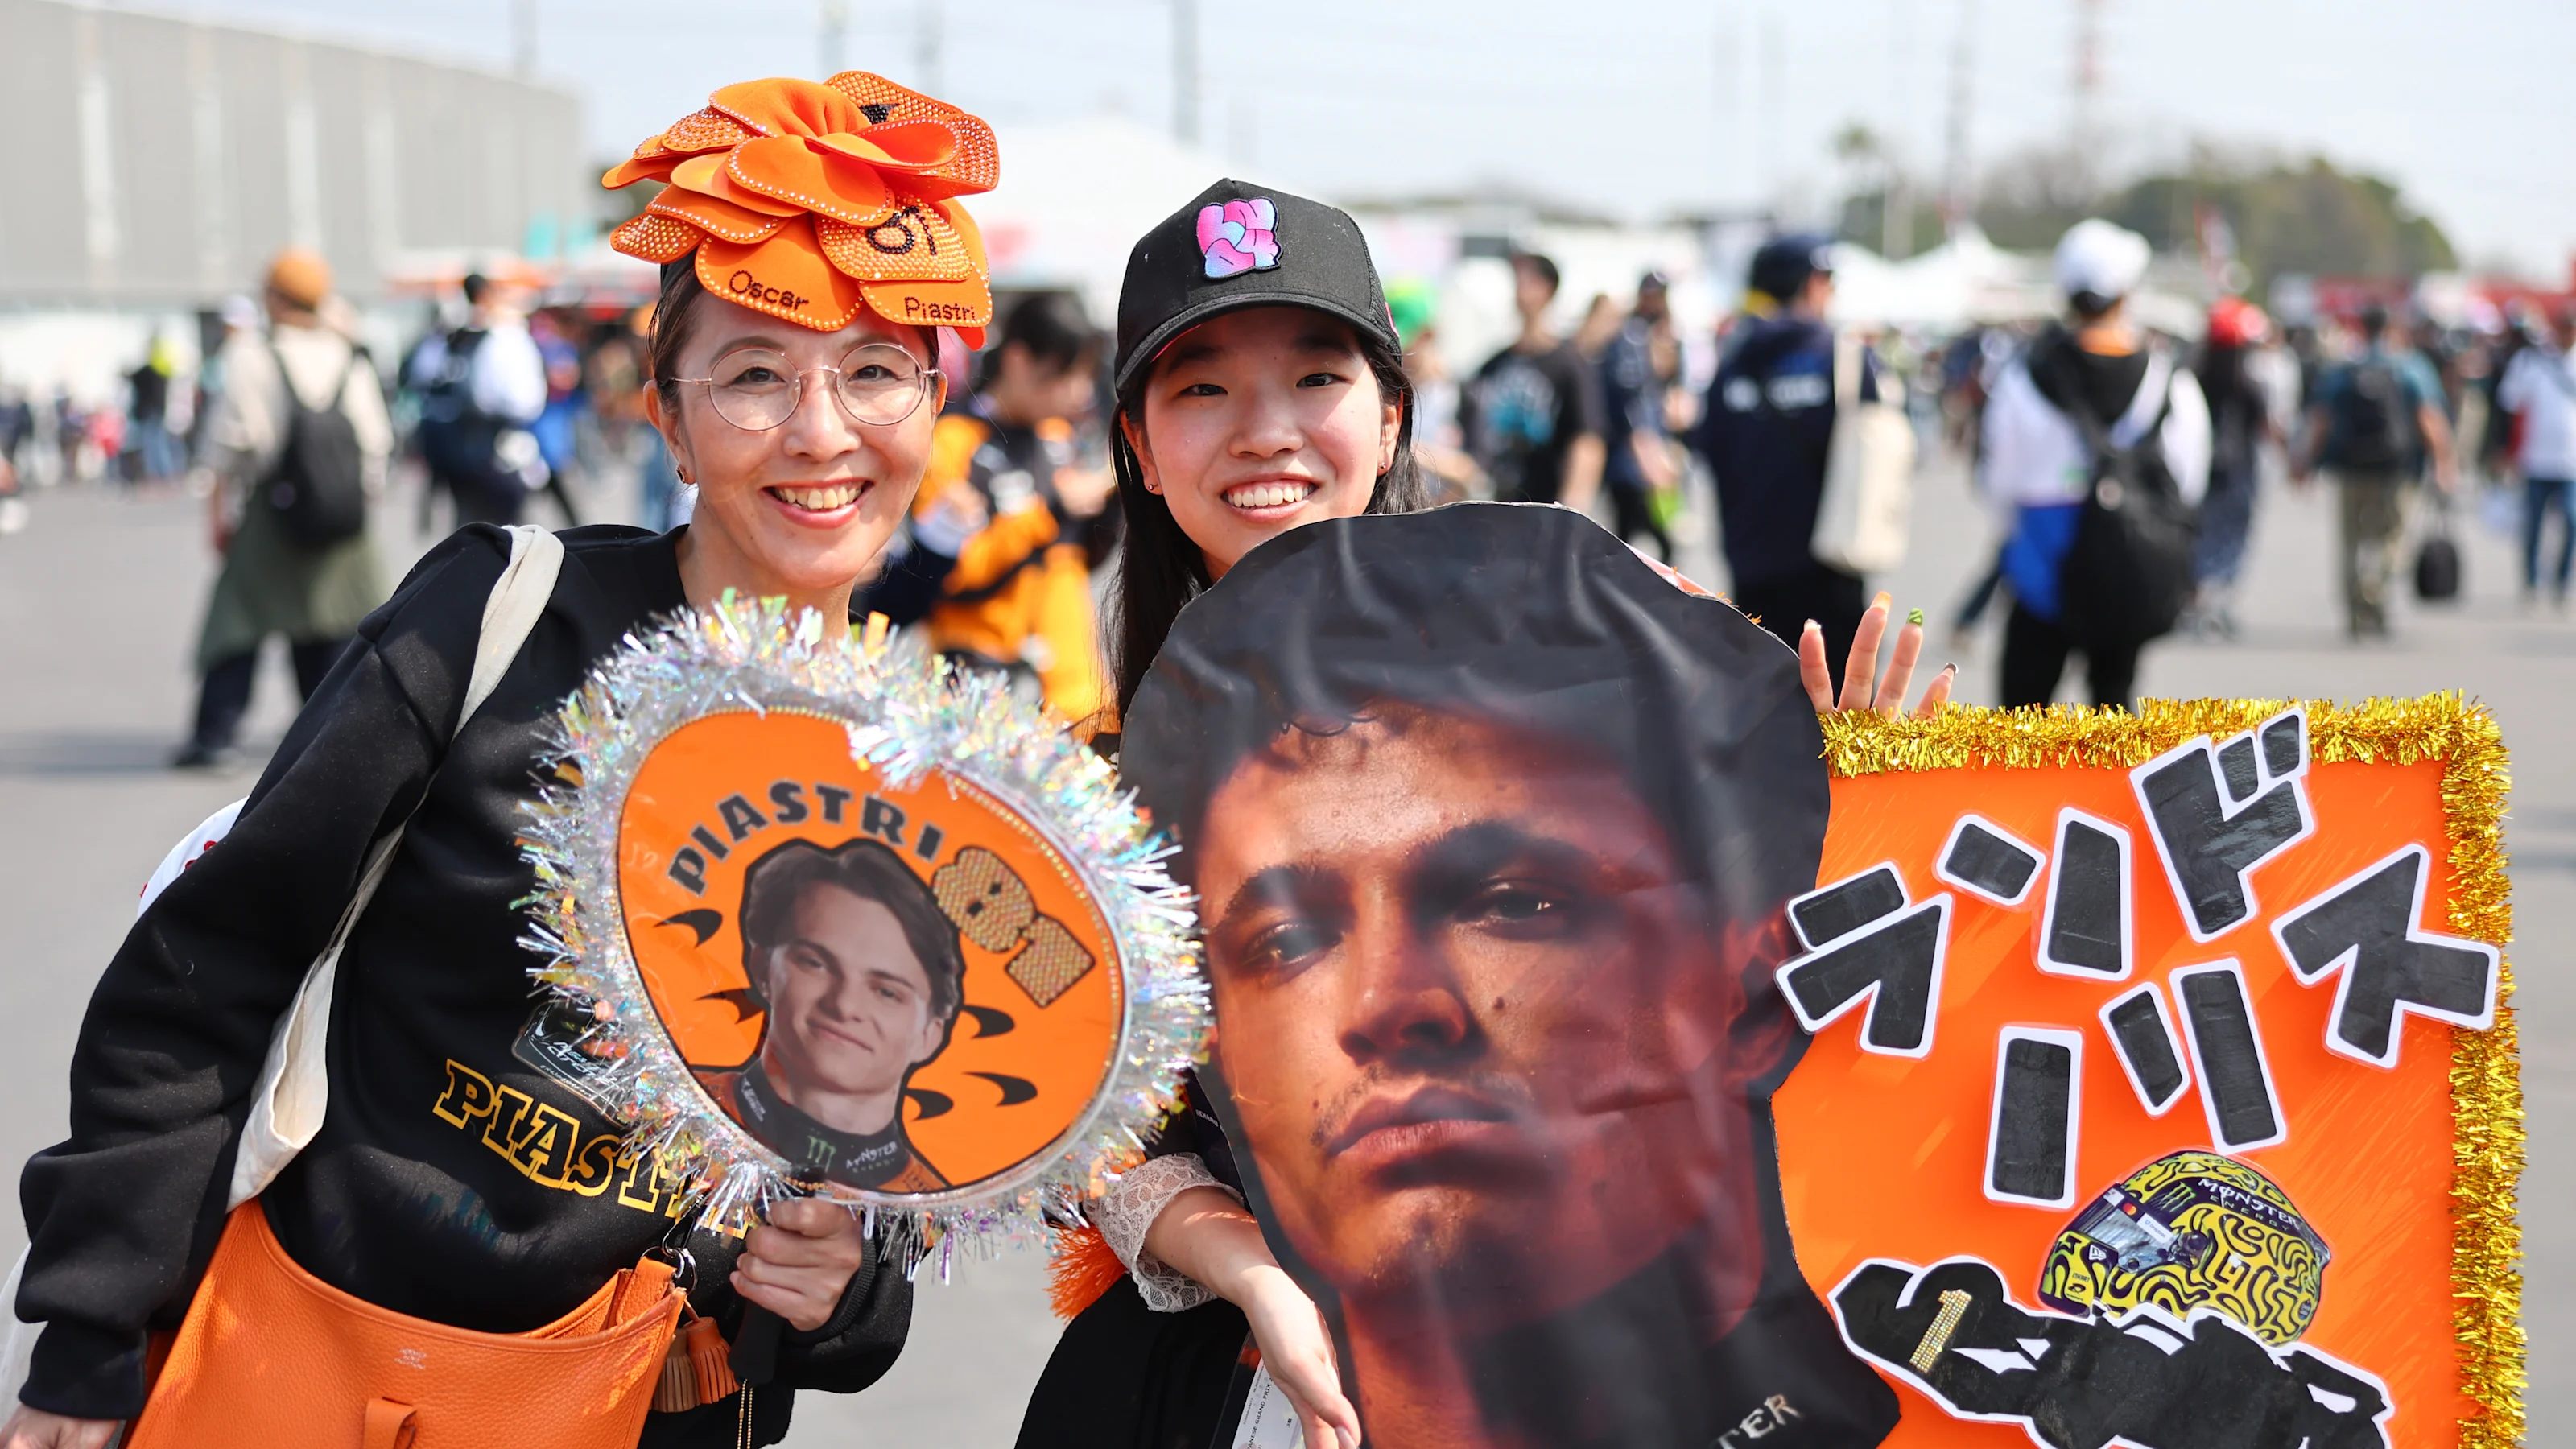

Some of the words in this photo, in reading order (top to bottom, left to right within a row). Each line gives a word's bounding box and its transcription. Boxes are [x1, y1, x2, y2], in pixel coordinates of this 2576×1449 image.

[729, 270, 809, 311] Oscar
[904, 296, 976, 321] Piastri
[667, 780, 945, 897] PIASTRI
[930, 845, 1096, 1009] 81
[432, 1059, 749, 1240] PIAST
[2198, 1178, 2298, 1227] MONSTER
[2211, 1195, 2288, 1232] ENERGY
[1909, 1290, 1972, 1373] 1
[1255, 1401, 1265, 1425] GRAND
[1262, 1384, 1272, 1400] PRIX
